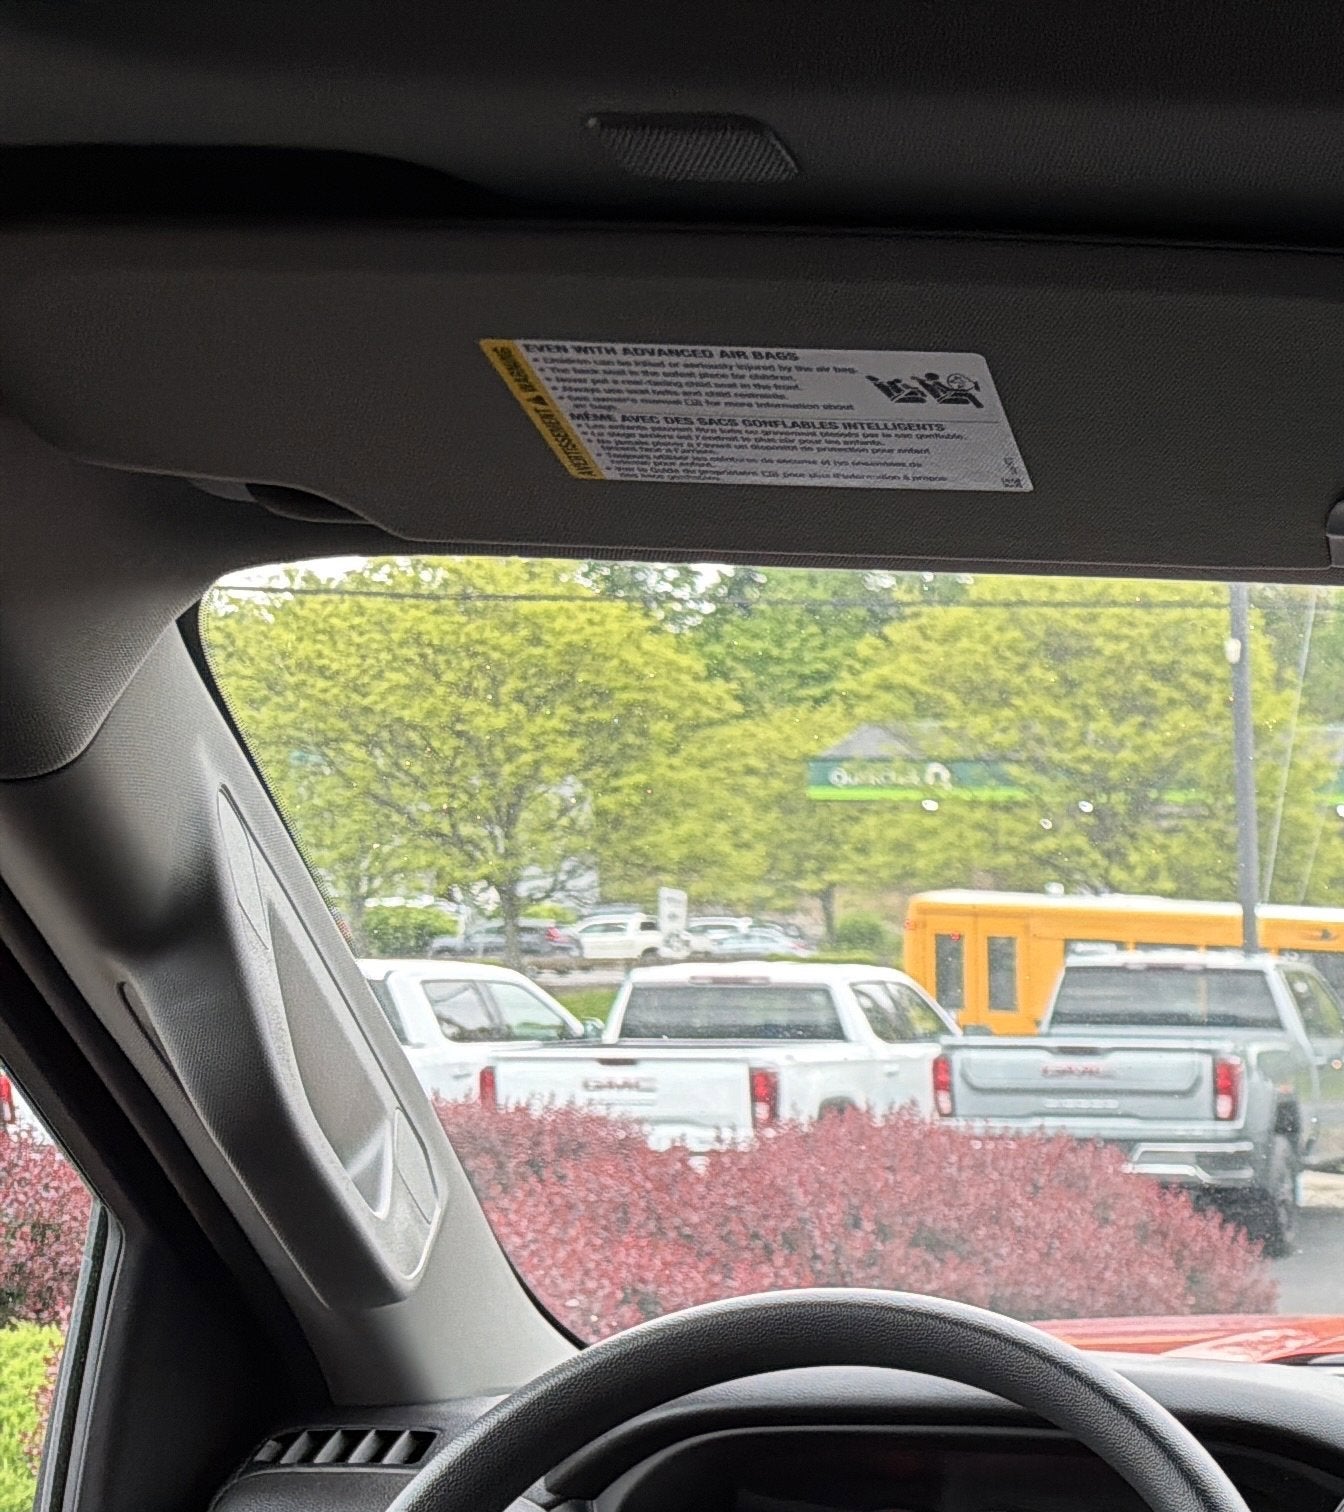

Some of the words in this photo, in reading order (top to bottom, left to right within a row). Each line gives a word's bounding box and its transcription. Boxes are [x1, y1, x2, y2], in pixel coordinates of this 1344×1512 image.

[524, 344, 568, 353] EVEN
[573, 345, 618, 355] WITH
[622, 347, 714, 358] ADVANCED
[719, 351, 749, 359] AIR
[752, 351, 799, 361] BAGS
[621, 415, 660, 424] AVEC
[664, 416, 694, 425] DES
[699, 418, 739, 426] SACS
[741, 419, 840, 430] GONFLABLES
[842, 422, 946, 432] INTELLIGENTS
